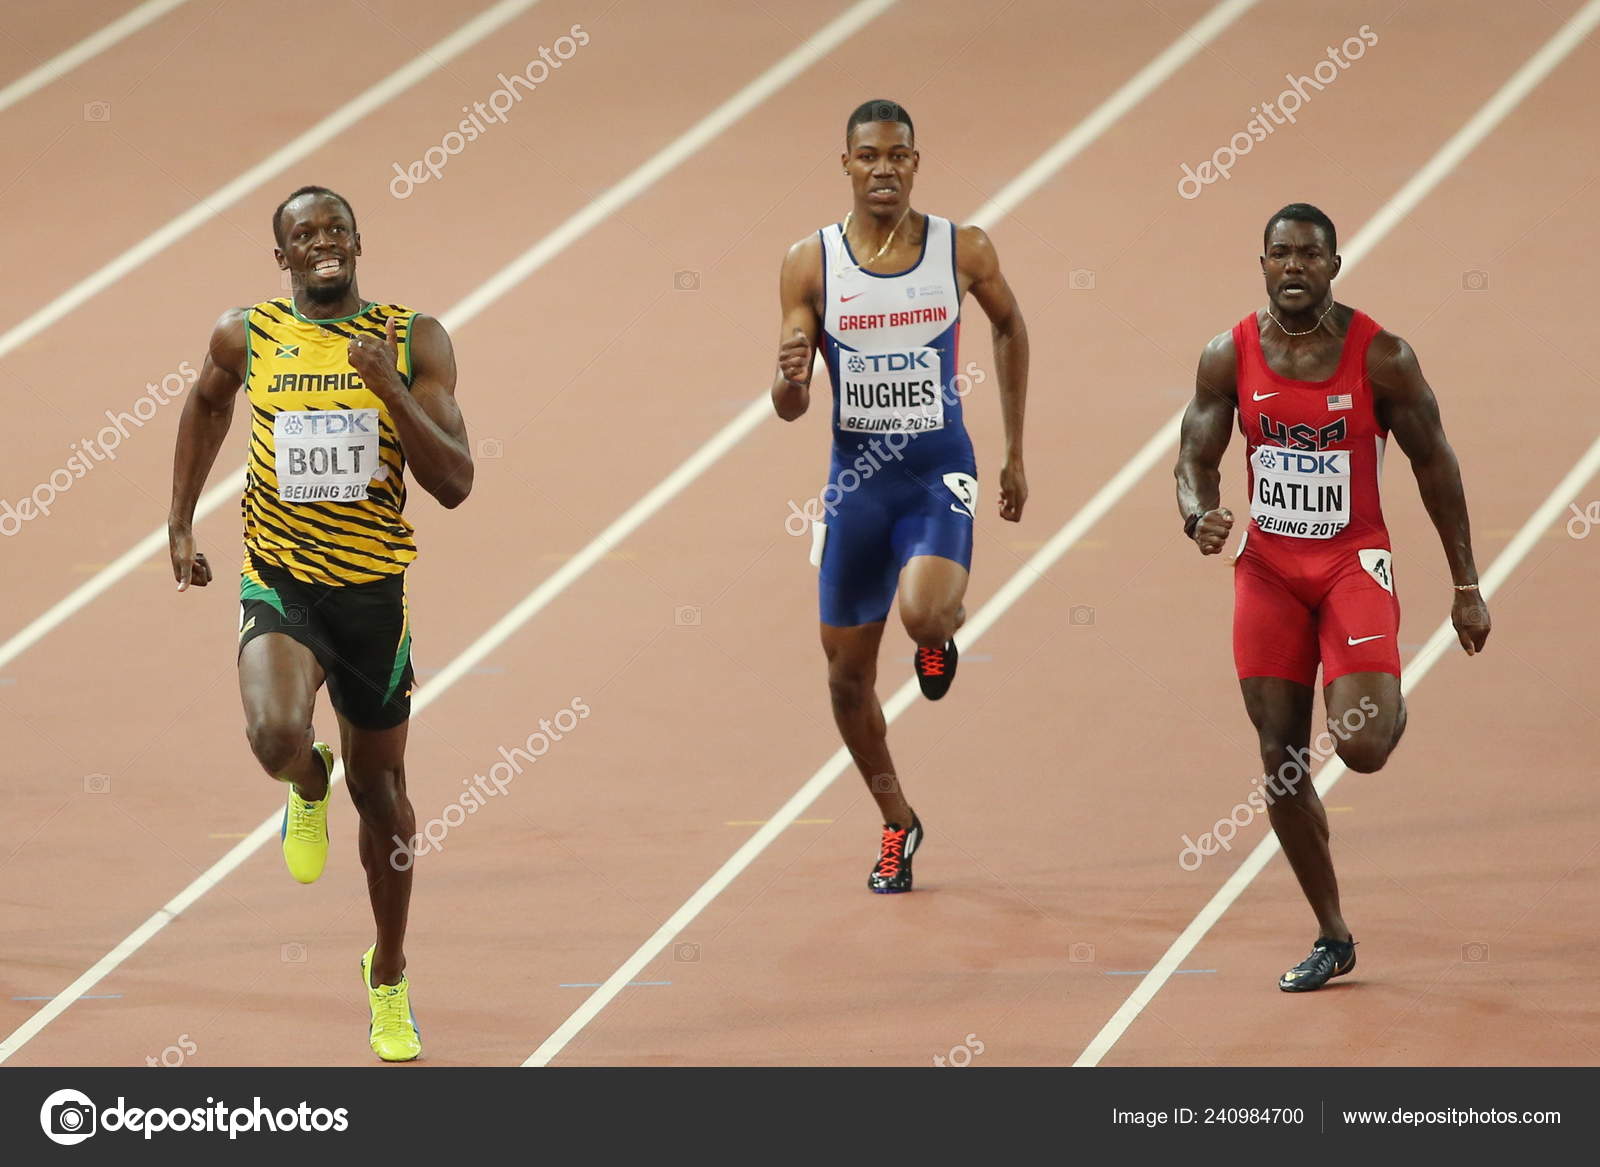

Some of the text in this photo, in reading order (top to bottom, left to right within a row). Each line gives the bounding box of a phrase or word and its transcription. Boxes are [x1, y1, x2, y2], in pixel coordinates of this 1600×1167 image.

[839, 306, 948, 331] GREAT BRITAIN
[865, 351, 930, 372] TDK
[268, 372, 364, 392] JAMAIC
[846, 379, 936, 409] HUGHES
[303, 412, 369, 434] TDK
[847, 415, 937, 431] BEIJING 2015
[1260, 412, 1347, 452] USA
[288, 445, 365, 476] BOLT
[1276, 451, 1341, 474] TDK
[284, 483, 367, 499] BEIJING 201
[1259, 477, 1343, 512] GATLIN
[1257, 515, 1308, 535] BEIJING
[1373, 558, 1388, 586] 4
